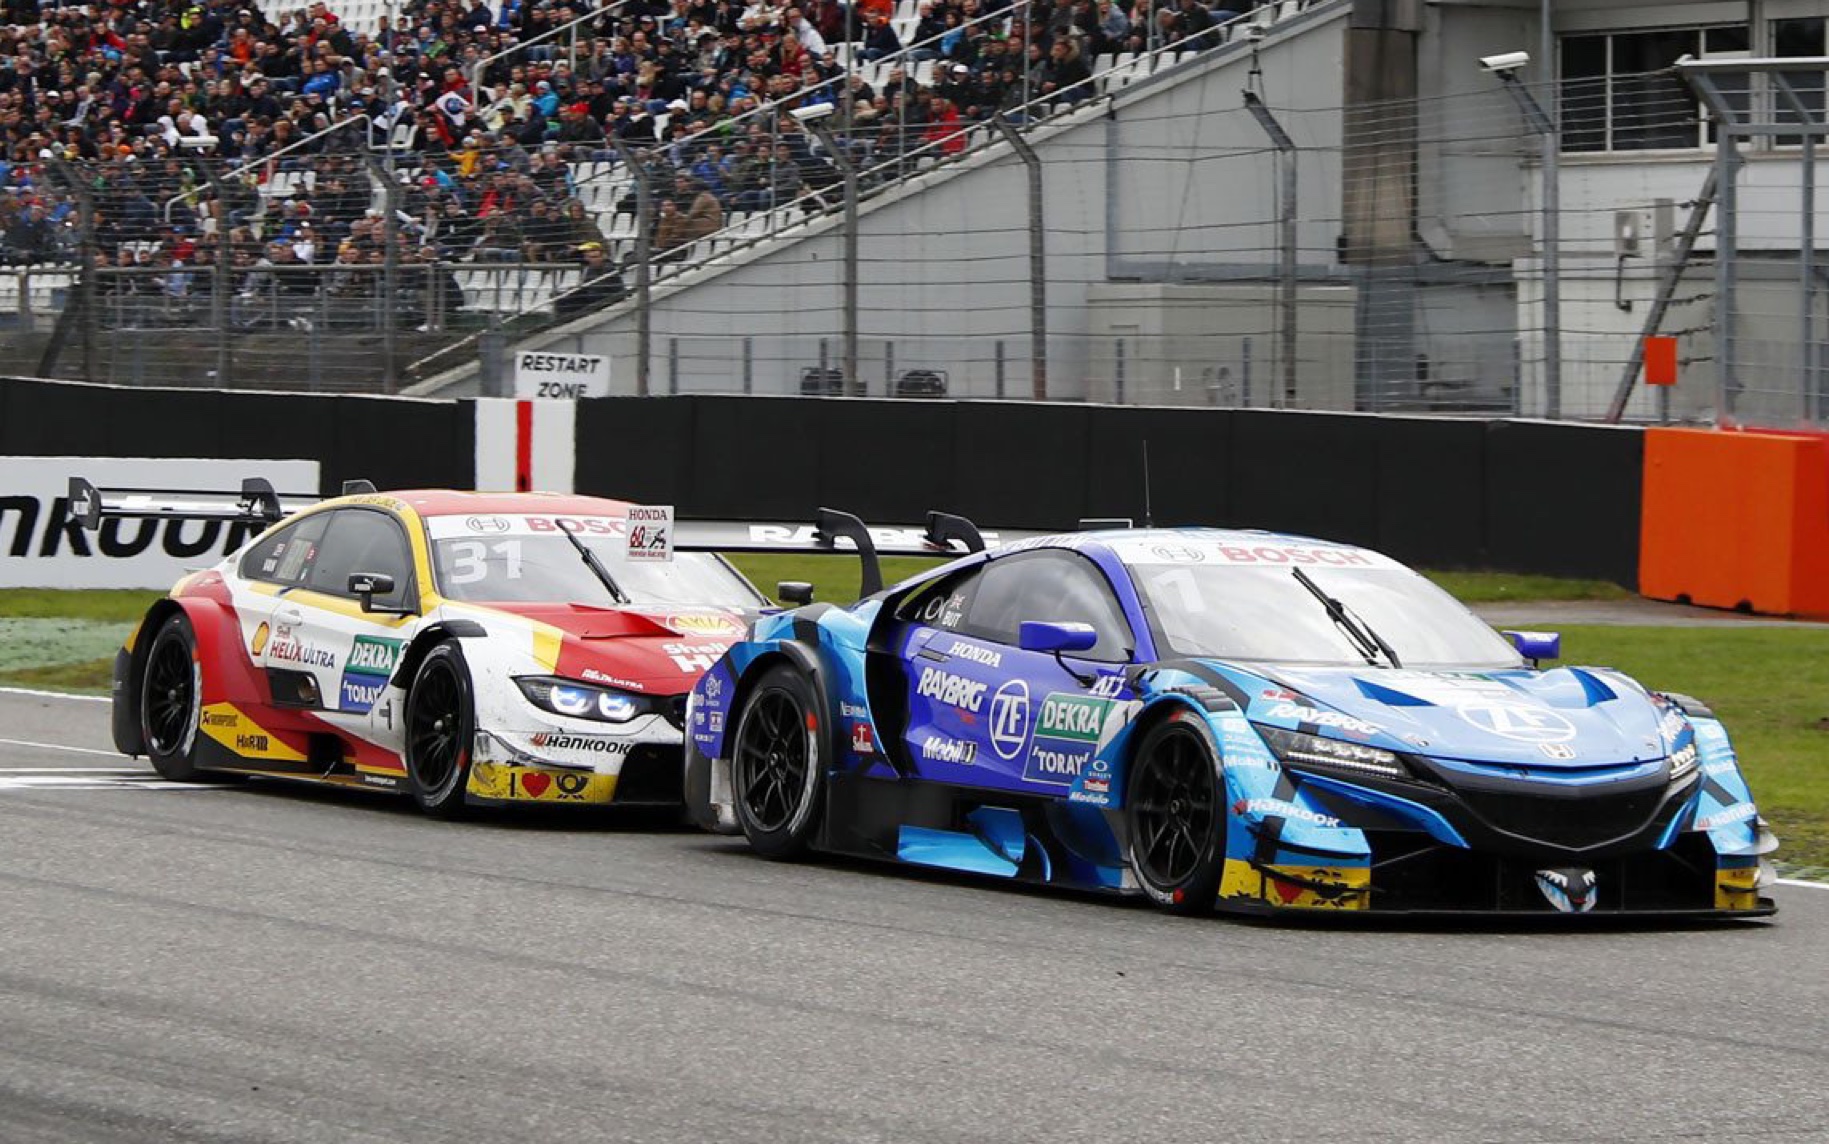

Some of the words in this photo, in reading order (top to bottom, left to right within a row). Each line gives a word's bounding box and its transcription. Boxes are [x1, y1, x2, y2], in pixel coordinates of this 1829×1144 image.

[521, 355, 601, 373] RESTART
[538, 382, 587, 398] ZONE
[525, 517, 626, 535] BOSC
[629, 509, 668, 520] HONDA
[451, 541, 523, 584] 31
[1217, 546, 1372, 566] BOSCH
[269, 641, 301, 662] HELIX
[303, 646, 335, 668] ULTRA
[352, 643, 393, 669] DEKRA
[948, 642, 1002, 668] HONDA
[917, 667, 988, 712] RAYBRIG
[994, 694, 1027, 742] ZF
[1042, 700, 1100, 734] DEKRA
[922, 736, 963, 764] Mobil
[509, 773, 516, 798] I
